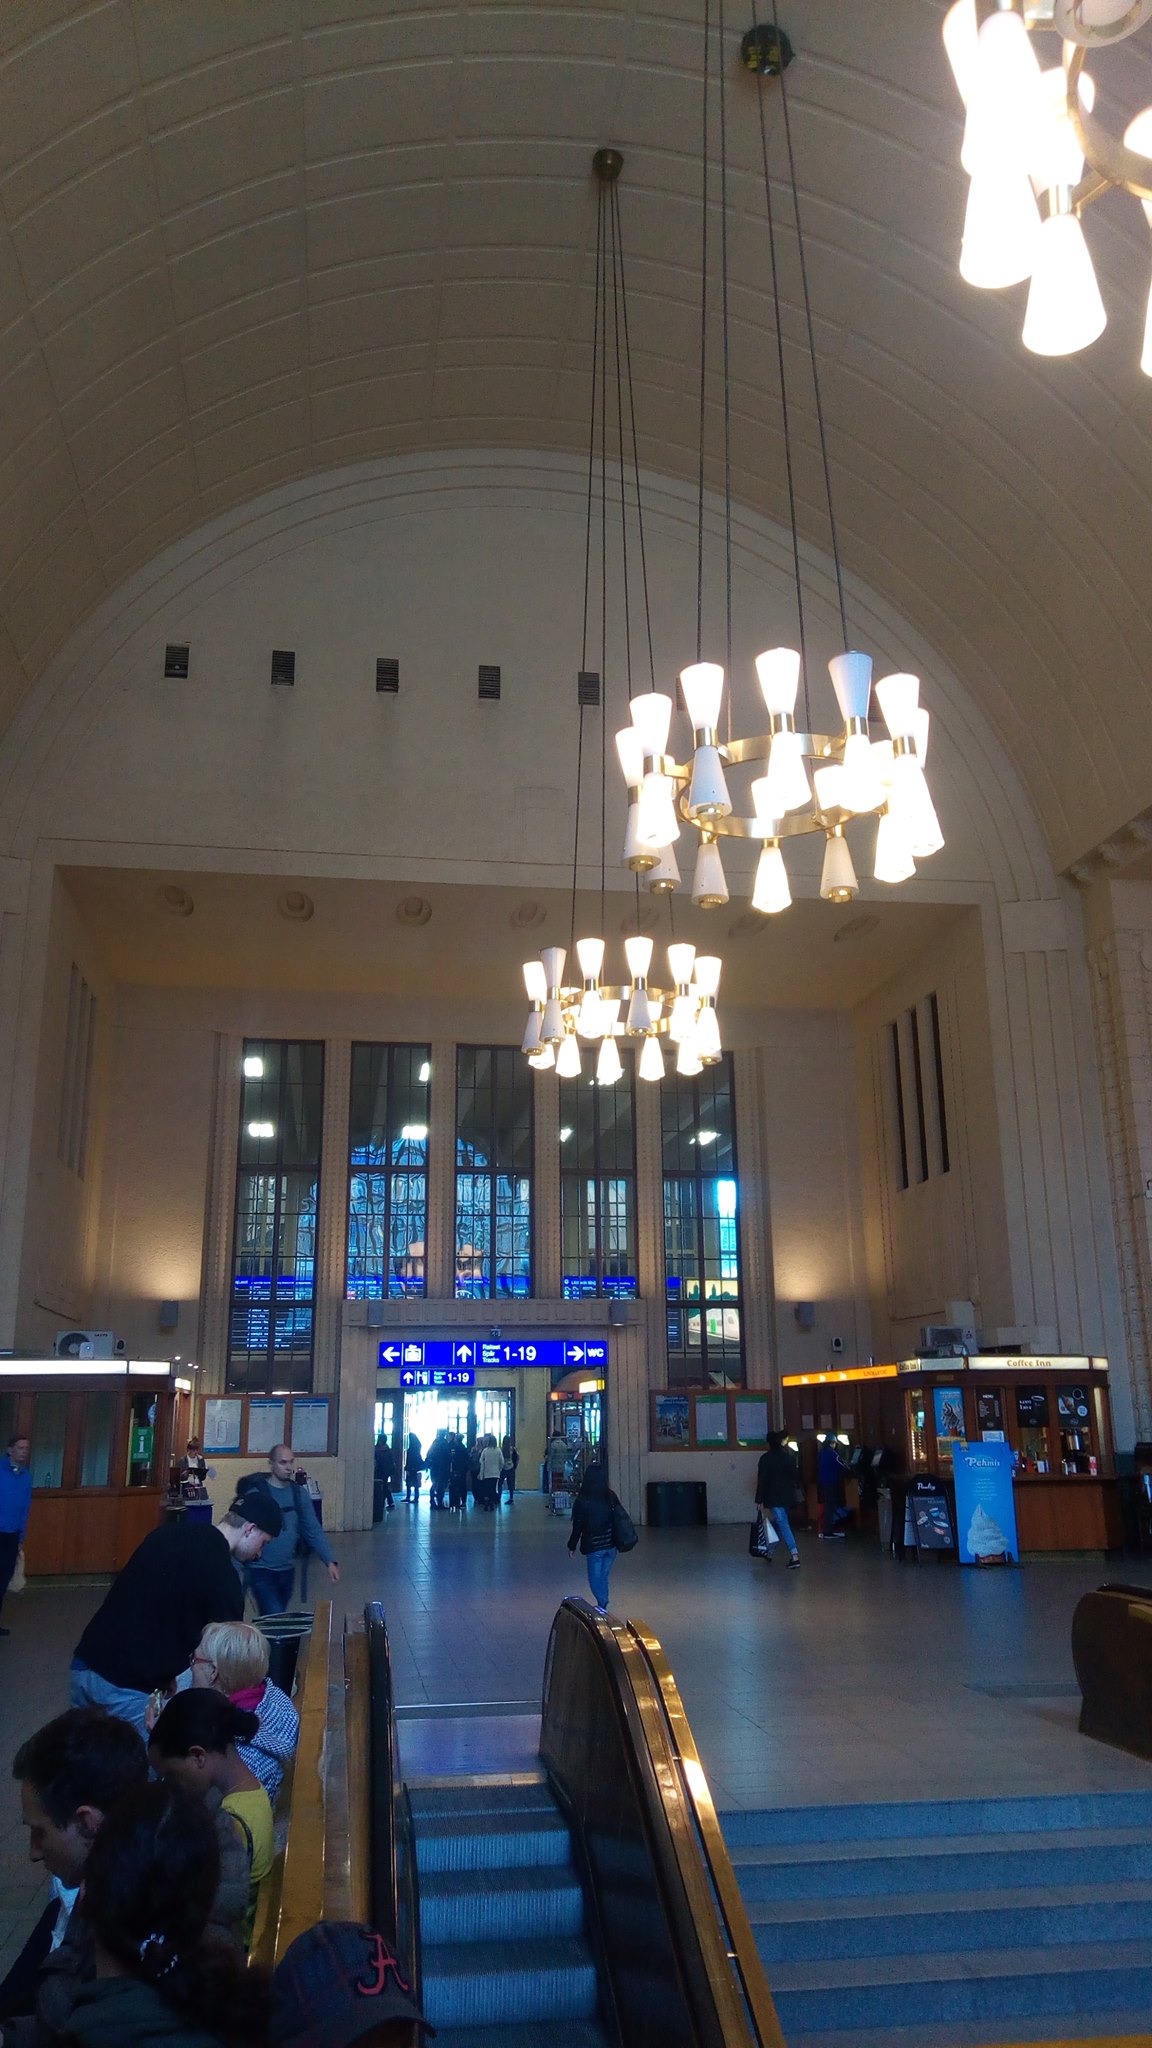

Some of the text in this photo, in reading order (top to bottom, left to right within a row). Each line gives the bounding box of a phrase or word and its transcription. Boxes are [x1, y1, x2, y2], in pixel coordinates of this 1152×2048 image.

[503, 1346, 537, 1361] 1-19
[587, 1348, 604, 1357] WC
[447, 1372, 470, 1383] 1-19
[357, 1933, 409, 1996] A
